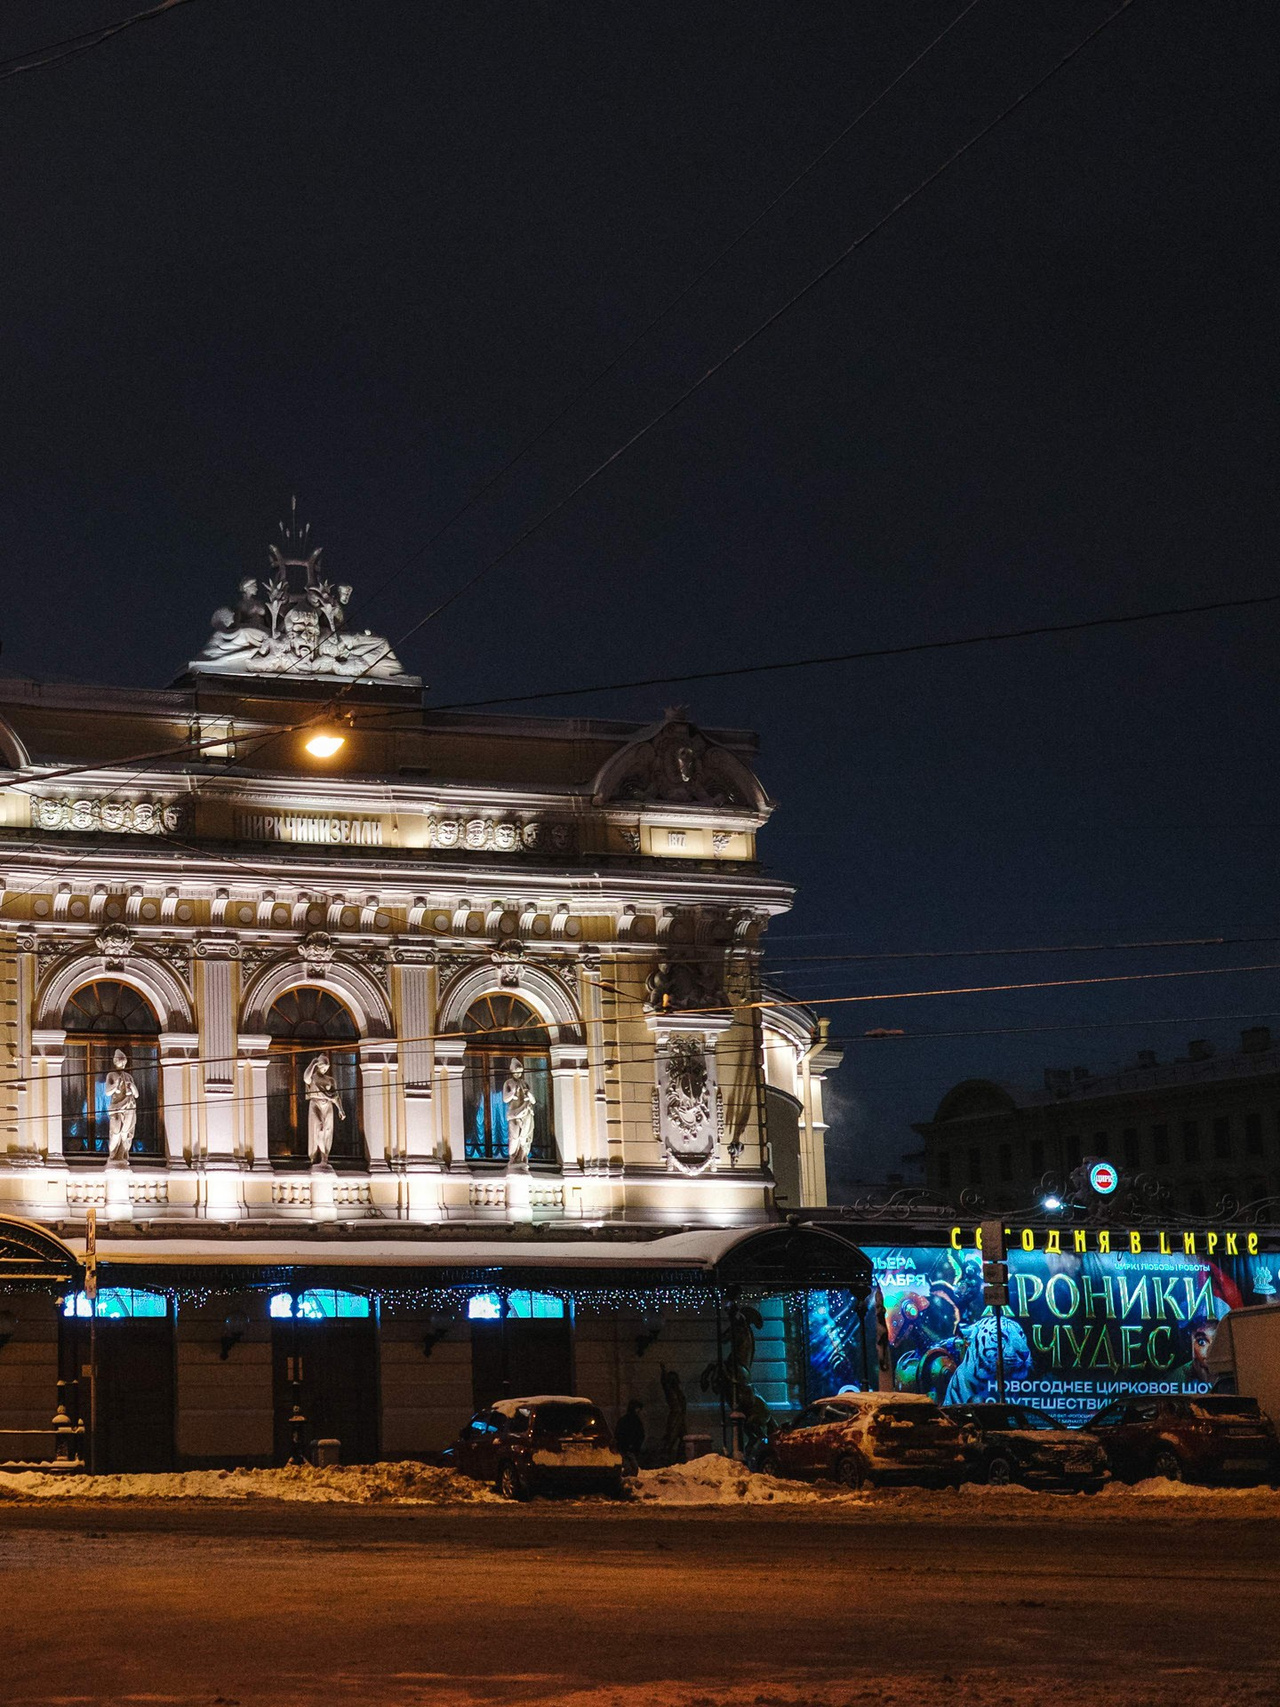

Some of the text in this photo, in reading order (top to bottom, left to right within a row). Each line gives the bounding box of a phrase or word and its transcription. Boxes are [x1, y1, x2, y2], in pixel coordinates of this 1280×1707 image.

[241, 815, 383, 844] ЦИРК ЧИНИЗЕЛЛИ
[950, 1227, 1110, 1255] СЕОДНЯ
[1130, 1231, 1142, 1254] В
[1140, 1263, 1175, 1271] ЛЮБОВЬ
[1178, 1264, 1210, 1272] РОБОТЫ
[1032, 1324, 1176, 1375] ЧУДЕС
[1096, 1381, 1179, 1396] ЦИРКОВОЕ
